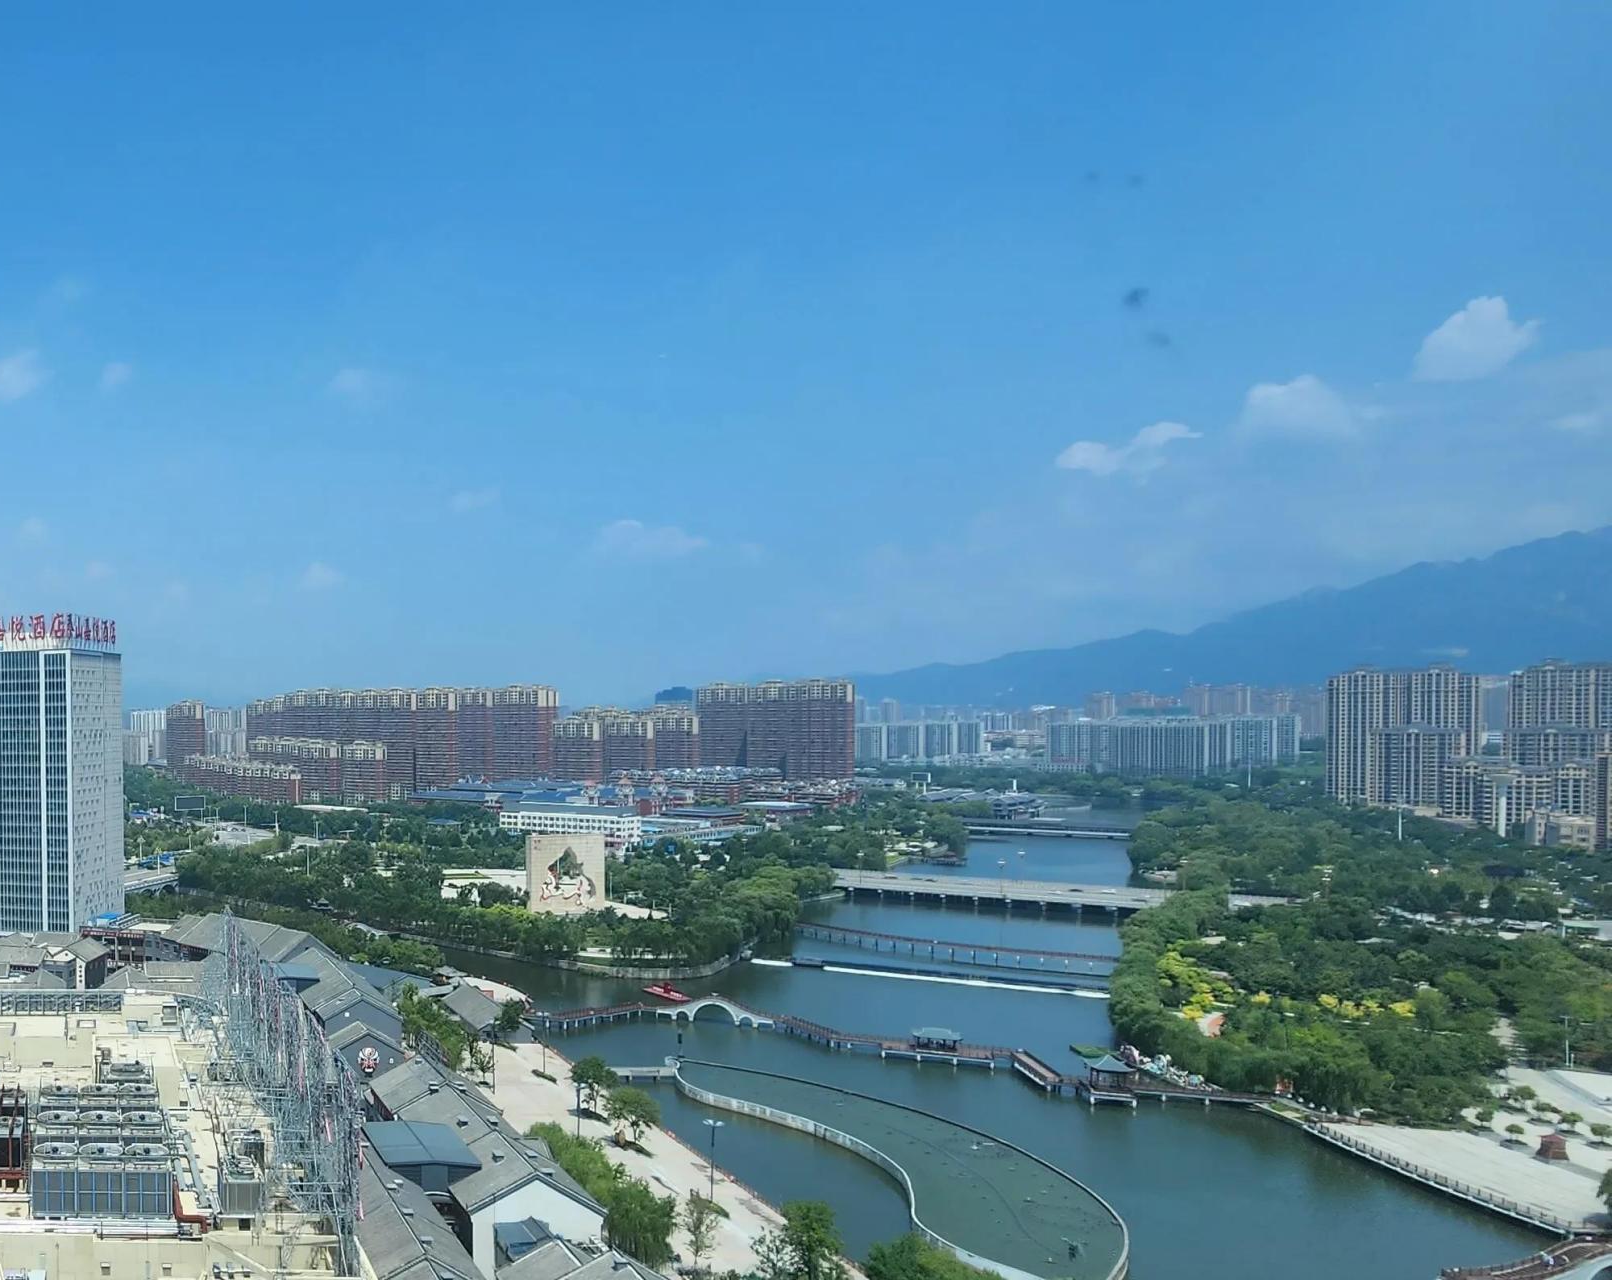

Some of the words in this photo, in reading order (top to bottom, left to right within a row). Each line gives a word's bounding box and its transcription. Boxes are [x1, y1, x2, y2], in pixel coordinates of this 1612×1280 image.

[66, 613, 116, 644] 泰山嘉悦酒店
